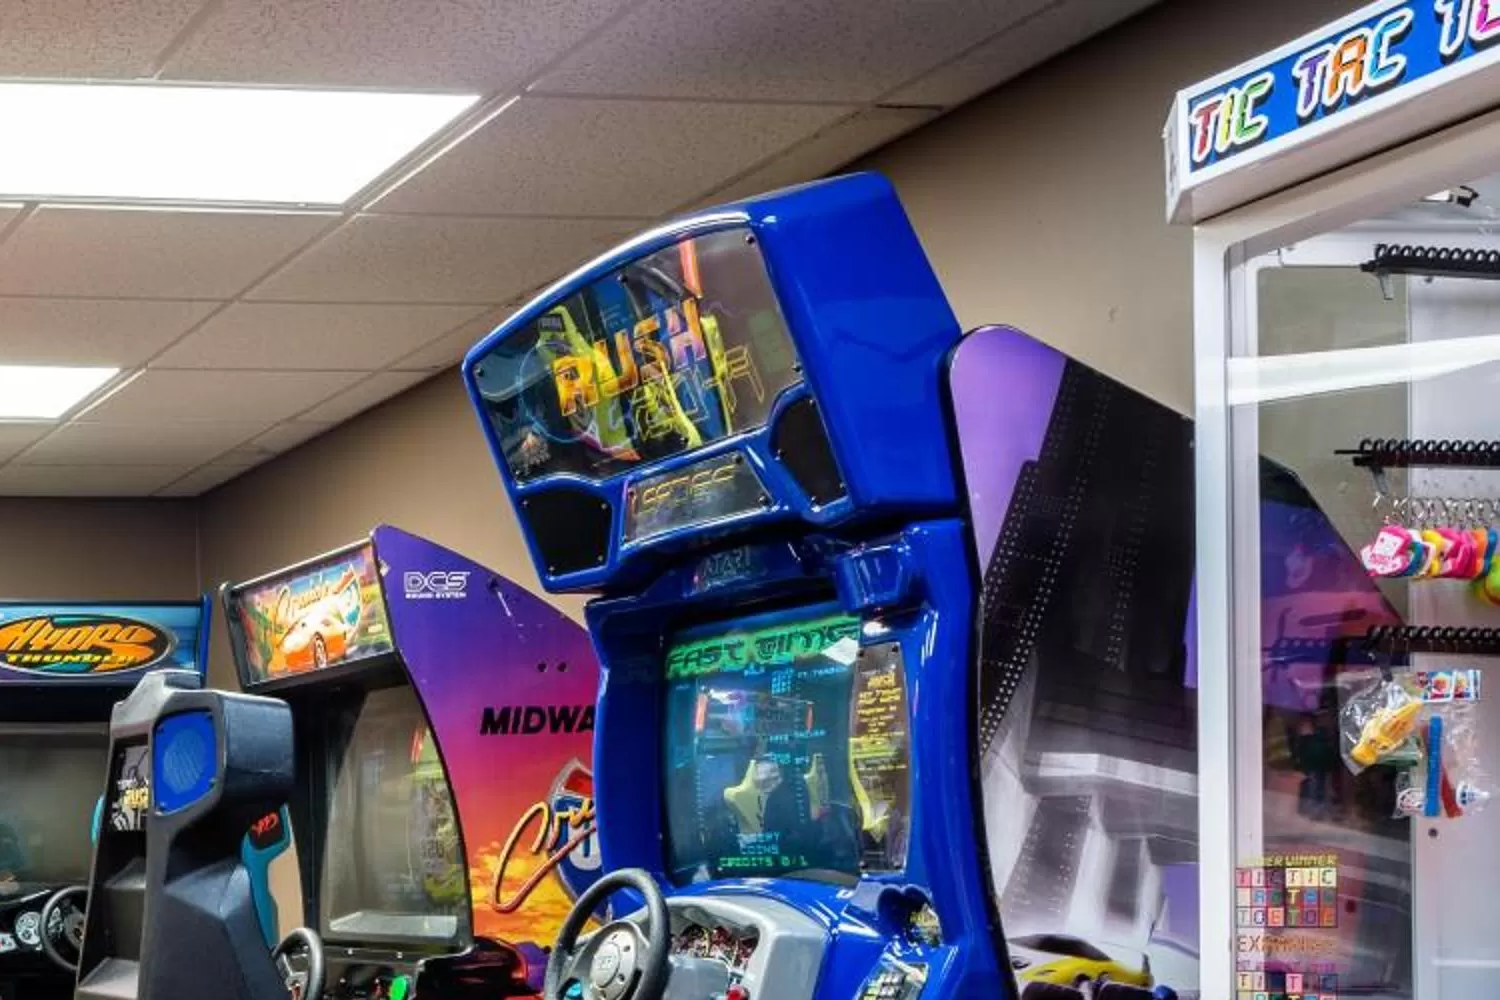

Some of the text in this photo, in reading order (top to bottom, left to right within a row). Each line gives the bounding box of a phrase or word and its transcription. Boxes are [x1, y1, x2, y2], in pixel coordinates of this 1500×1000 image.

[1191, 71, 1274, 163] TIC
[1292, 8, 1414, 118] TAC
[404, 571, 470, 592] DCS
[480, 705, 596, 735] MIDWA
